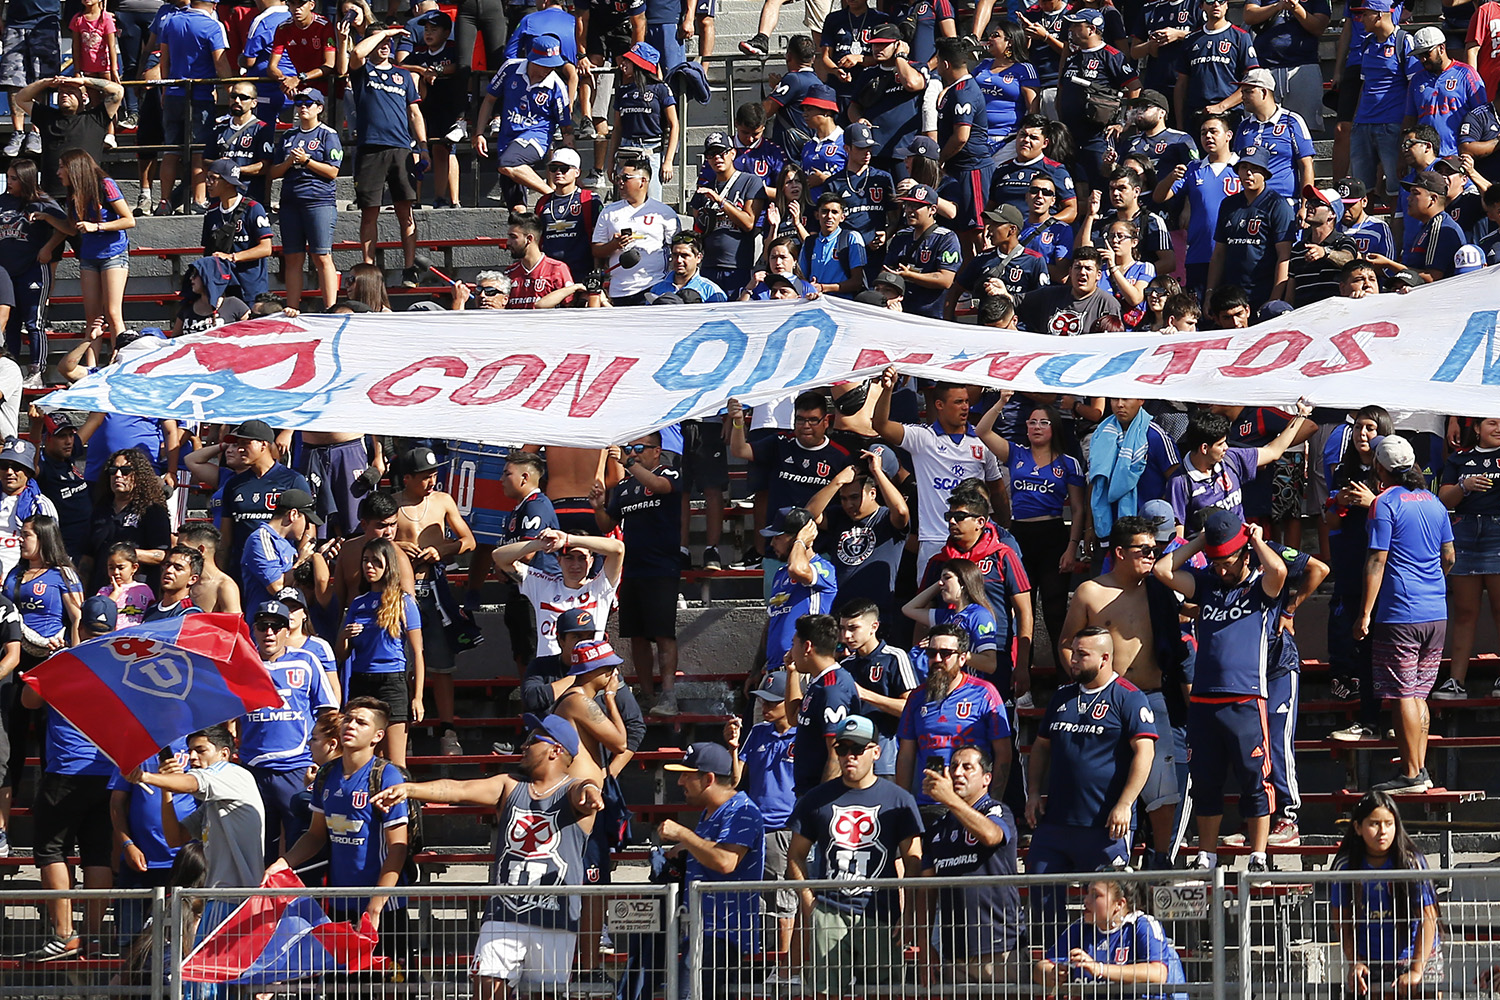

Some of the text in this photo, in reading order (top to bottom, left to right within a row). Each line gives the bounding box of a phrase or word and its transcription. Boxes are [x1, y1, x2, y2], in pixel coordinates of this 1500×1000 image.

[367, 353, 639, 418] CON
[651, 308, 840, 425] 90
[1013, 478, 1055, 494] Claro
[237, 512, 274, 522] PETROBR
[1202, 599, 1252, 621] Claro
[138, 657, 184, 688] U
[1049, 722, 1104, 735] PETROBRAS
[1173, 887, 1205, 899] VDS
[629, 902, 654, 912] VDS
